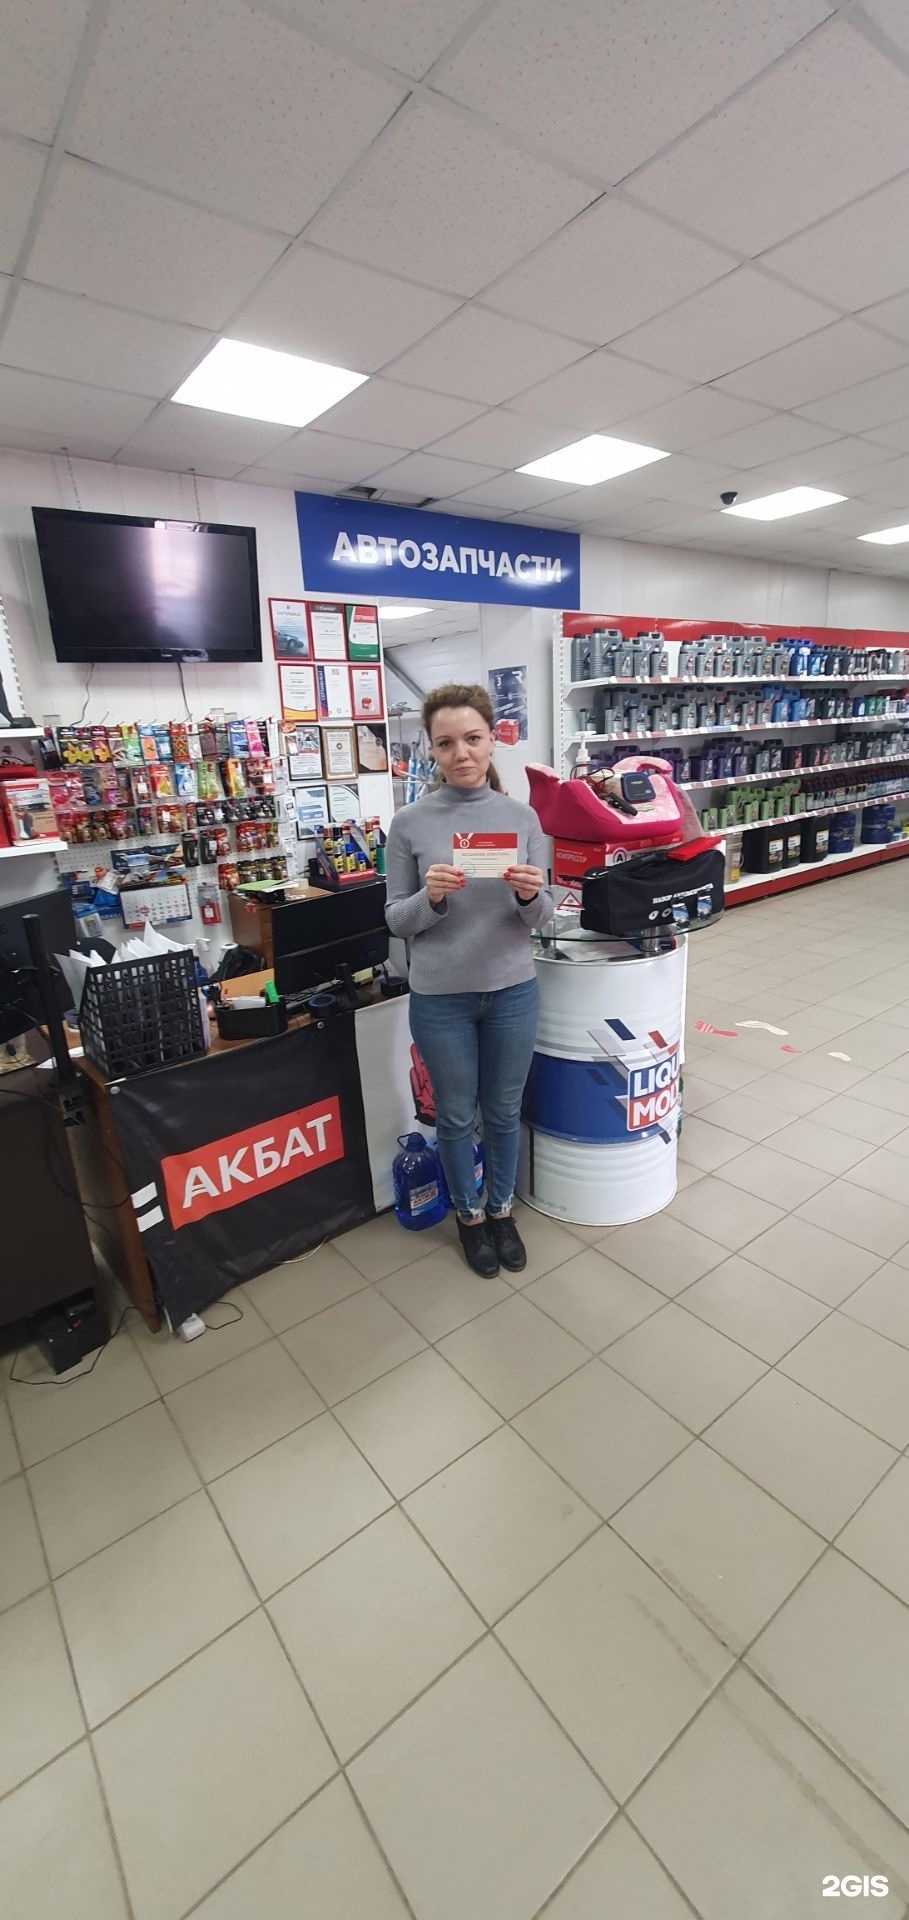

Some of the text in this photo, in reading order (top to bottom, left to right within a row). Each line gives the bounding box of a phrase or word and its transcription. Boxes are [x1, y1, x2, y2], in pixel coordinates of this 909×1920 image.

[332, 532, 562, 583] АВТОЗАПЧАСТИ
[633, 1052, 679, 1098] LIQU
[632, 1083, 678, 1126] MOL
[182, 1113, 332, 1209] АКБАТ
